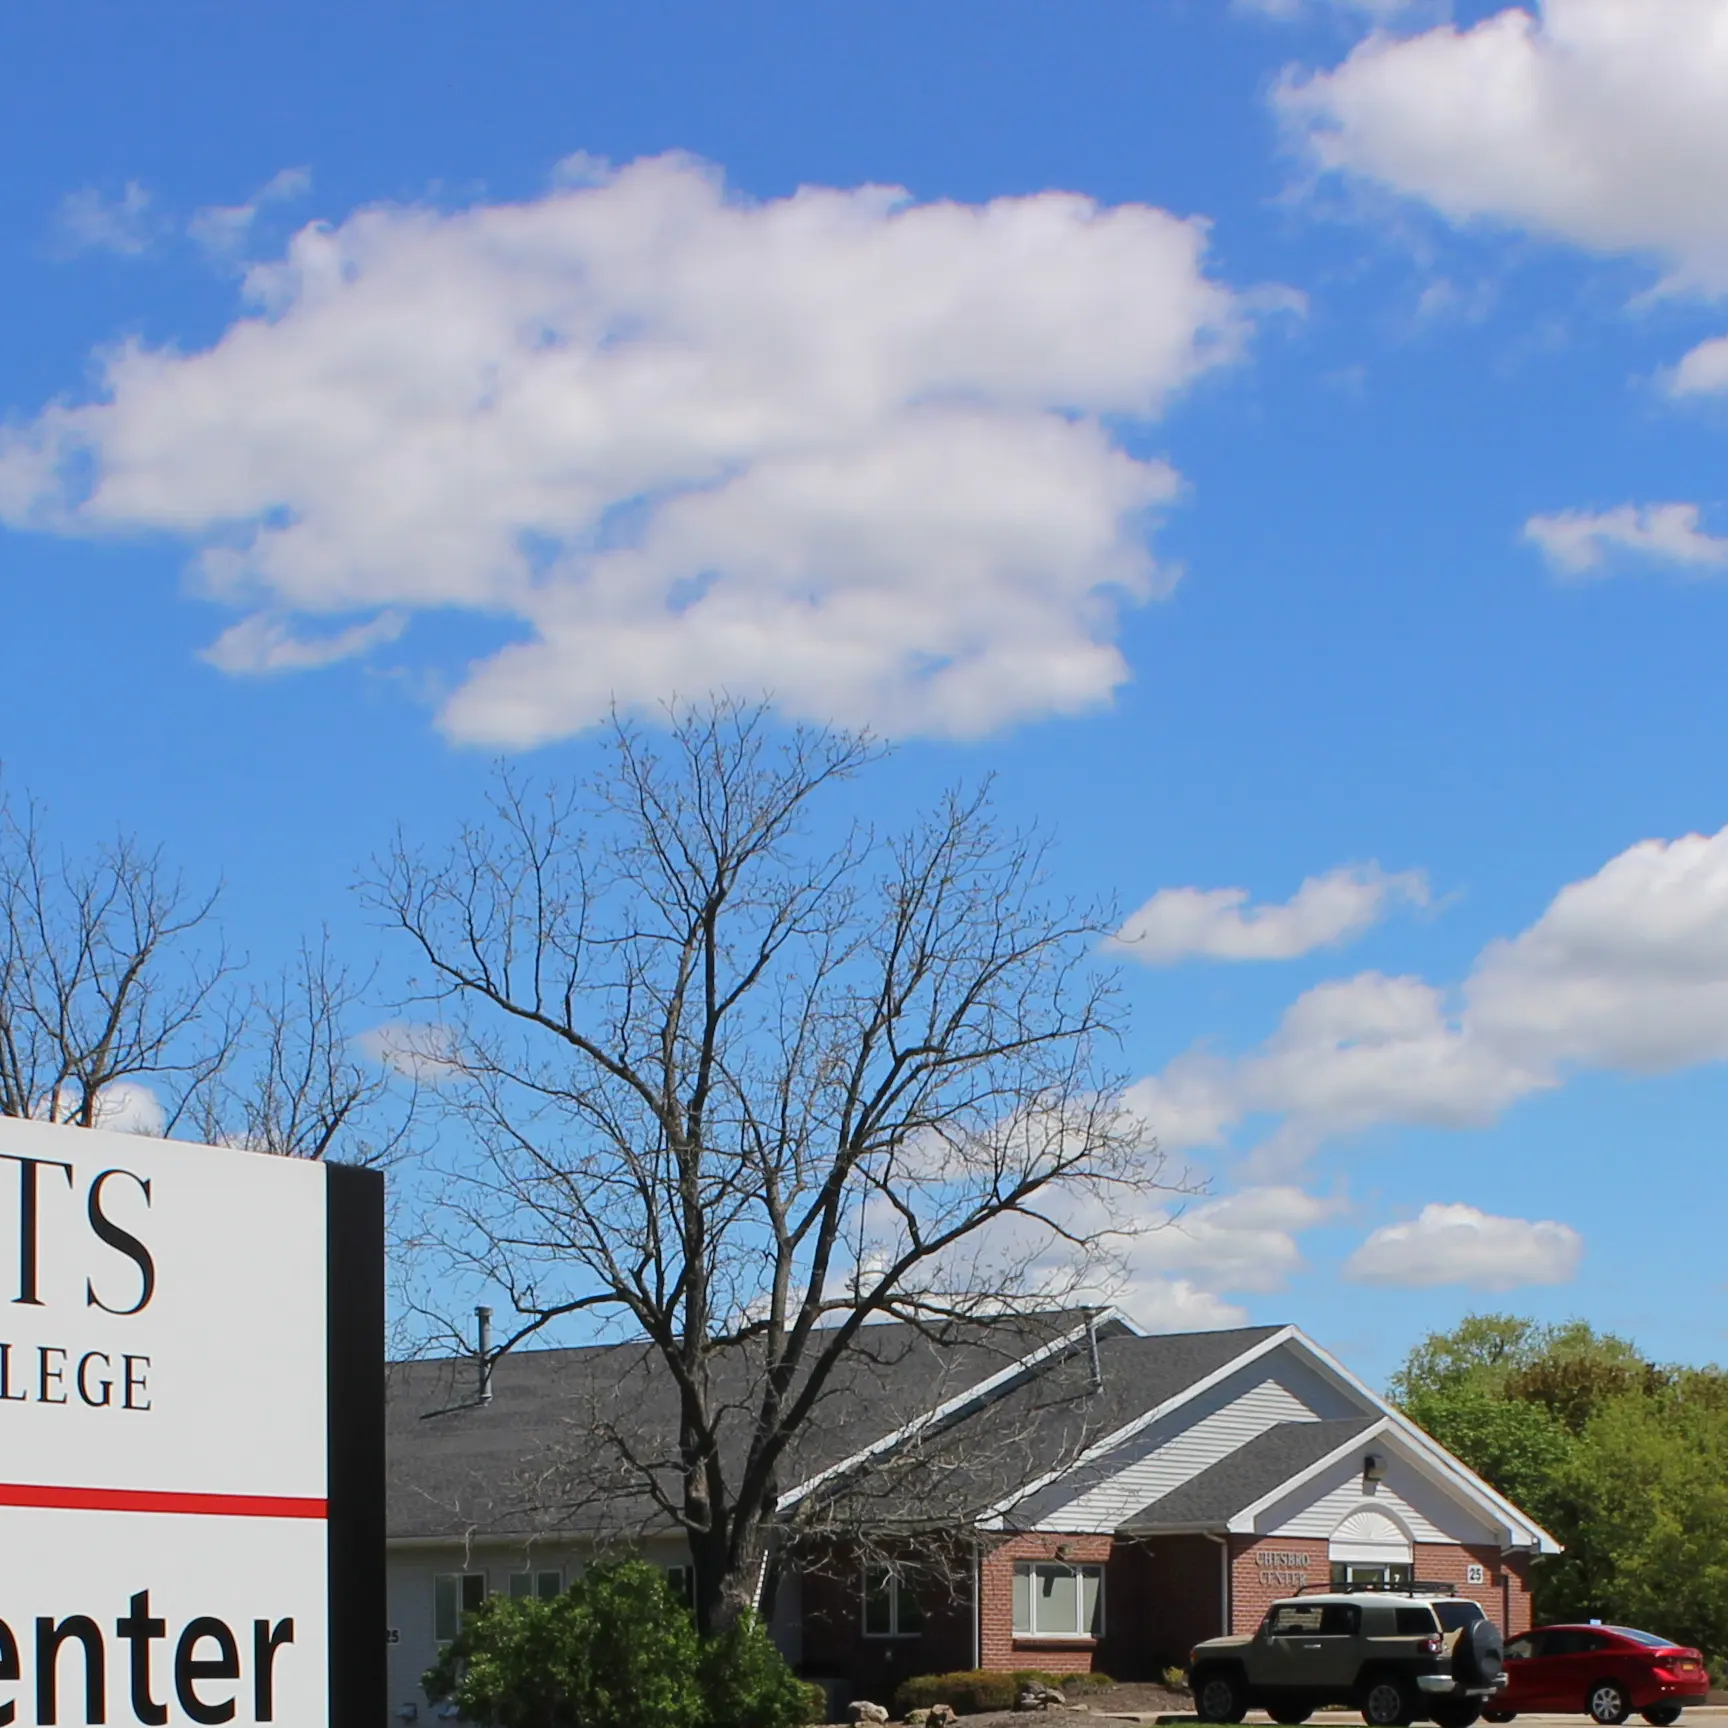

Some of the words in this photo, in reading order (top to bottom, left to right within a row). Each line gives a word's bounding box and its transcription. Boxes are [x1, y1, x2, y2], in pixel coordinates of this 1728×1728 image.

[1255, 1551, 1310, 1568] CHESBRO
[1259, 1570, 1307, 1588] CENTER
[1468, 1567, 1482, 1582] 25
